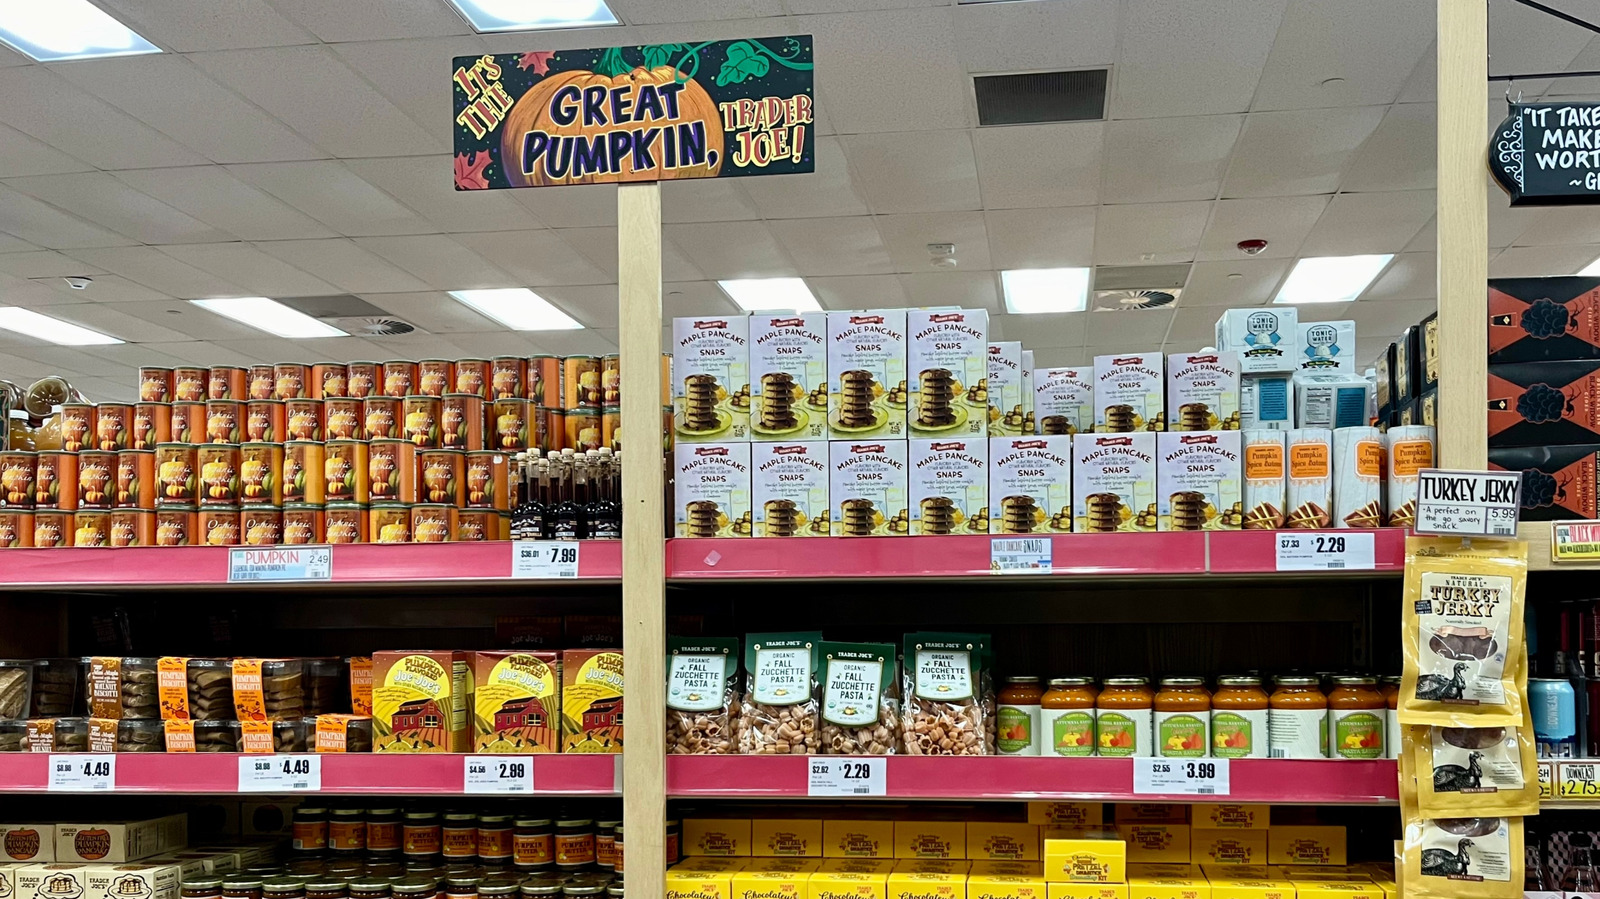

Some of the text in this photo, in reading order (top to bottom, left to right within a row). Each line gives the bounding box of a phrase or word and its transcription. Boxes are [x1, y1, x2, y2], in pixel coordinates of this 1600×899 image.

[453, 54, 503, 98] IT'S
[456, 81, 515, 141] THE
[550, 81, 687, 128] GREAT
[719, 95, 814, 131] TRADER
[522, 120, 719, 180] PUMPKIN,
[733, 126, 805, 168] JOE!
[1252, 316, 1274, 324] TONIC
[680, 331, 706, 347] MAPLE
[708, 330, 746, 346] PANCAKE
[758, 330, 783, 345] MAPLE
[785, 329, 823, 344] PANCAKE
[835, 327, 903, 343] MAPLE PANCAKE
[915, 324, 983, 341] MAPLE PANCAKE
[777, 347, 803, 355] SNAPS
[935, 342, 962, 350] SNAPS
[1100, 366, 1159, 381] MAPLE PANCAKE
[1174, 365, 1234, 379] MAPLE PANCAKE
[1192, 380, 1216, 388] SNAPS
[917, 452, 985, 469] MAPLE PANCAKE
[1081, 446, 1152, 465] MAPLE PANCAKE
[1252, 452, 1278, 460] Pumpkin
[1296, 451, 1323, 460] Pumpkin
[681, 457, 747, 474] MAPLE PANCAKE
[837, 455, 904, 472] MAPLE PANCAKE
[1102, 466, 1130, 474] SNAPS
[1247, 459, 1263, 469] Spice
[1291, 459, 1308, 469] Spice
[857, 473, 884, 481] SNAPS
[936, 471, 964, 479] SNAPS
[1421, 477, 1519, 504] TURKEY JERKY
[1434, 506, 1460, 515] perfect
[1491, 508, 1516, 519] 5.99
[1443, 516, 1452, 524] go
[1458, 517, 1481, 525] savory
[1023, 540, 1043, 553] SNAPS
[1281, 540, 1300, 549] $7.33
[246, 551, 299, 565] PUMPKIN
[309, 555, 329, 564] 2.49
[1430, 586, 1501, 604] TURKEY
[1435, 601, 1495, 618] JERKY
[405, 658, 444, 678] PUMPKIN
[509, 656, 548, 676] PUMPKIN
[688, 664, 707, 672] FALL
[774, 660, 793, 668] FALL
[405, 666, 438, 681] FLAVORED
[511, 665, 543, 679] FLAVORED
[674, 672, 720, 680] ZUCCHETTE
[761, 668, 805, 676] ZUCCHETTE
[845, 672, 863, 681] FALL
[162, 680, 186, 688] BISCOTTI
[394, 670, 440, 694] Joe-Joe's
[498, 668, 545, 692] Joe-Joe's
[684, 680, 708, 688] PASTA
[831, 681, 875, 691] ZUCCHETTE
[840, 691, 864, 700] PASTA
[1547, 690, 1558, 730] DOWNEAST
[320, 740, 345, 748] BISCOTTI
[1152, 763, 1171, 773] $2.55
[1566, 767, 1595, 780] DOWNEAST
[1072, 863, 1102, 871] PRETZEL
